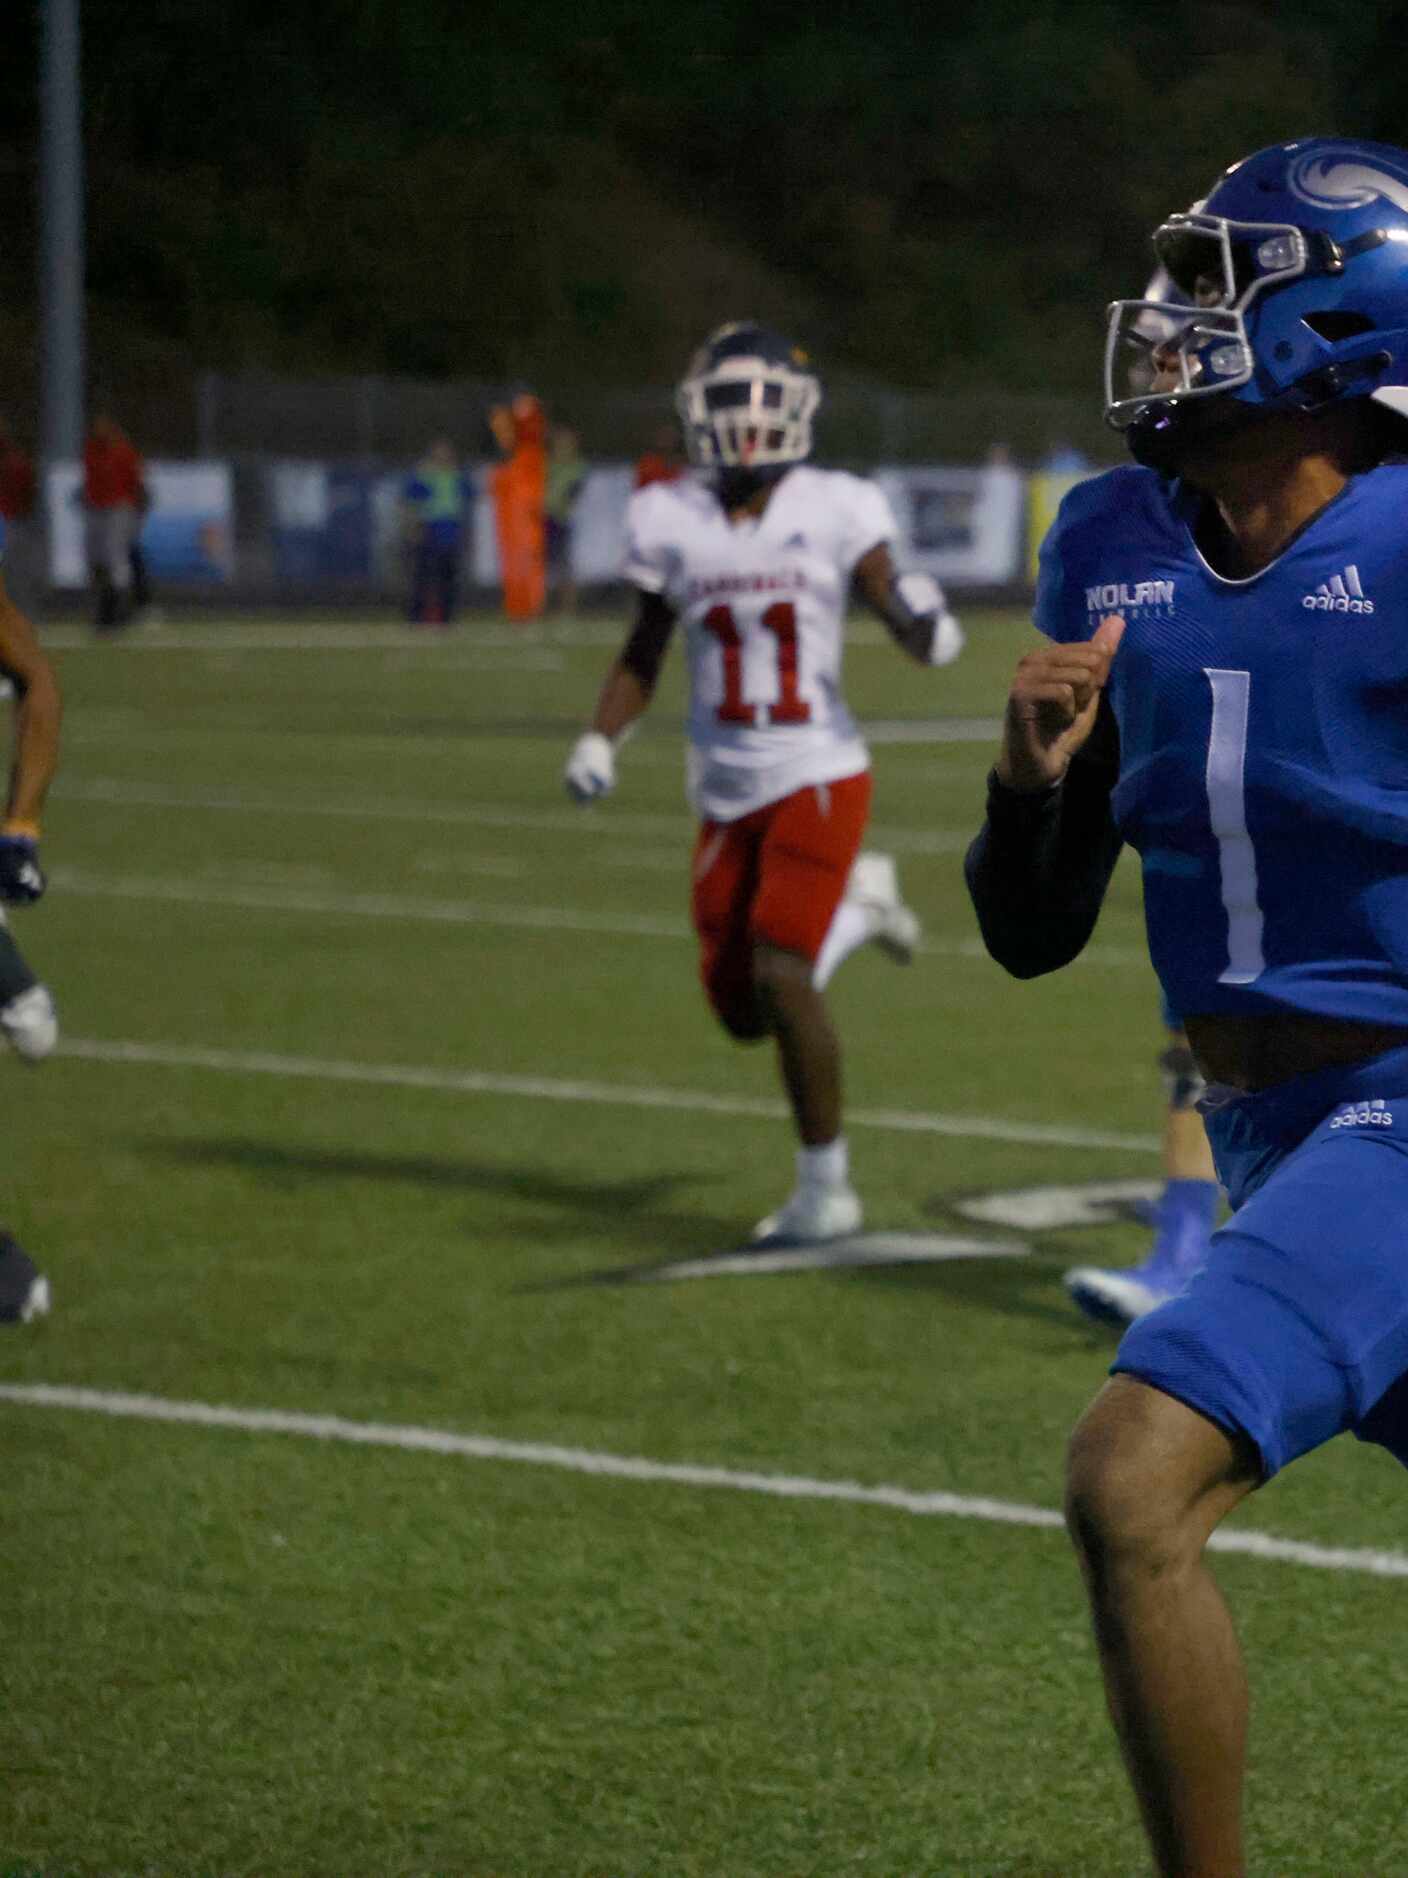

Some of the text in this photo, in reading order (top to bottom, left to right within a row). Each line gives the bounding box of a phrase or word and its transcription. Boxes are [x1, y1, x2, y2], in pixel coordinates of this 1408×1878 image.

[1086, 581, 1175, 611] NOLAN
[1302, 593, 1374, 614] adidas
[703, 601, 812, 725] 11
[1202, 666, 1266, 985] 1
[1329, 1108, 1393, 1129] adidas
